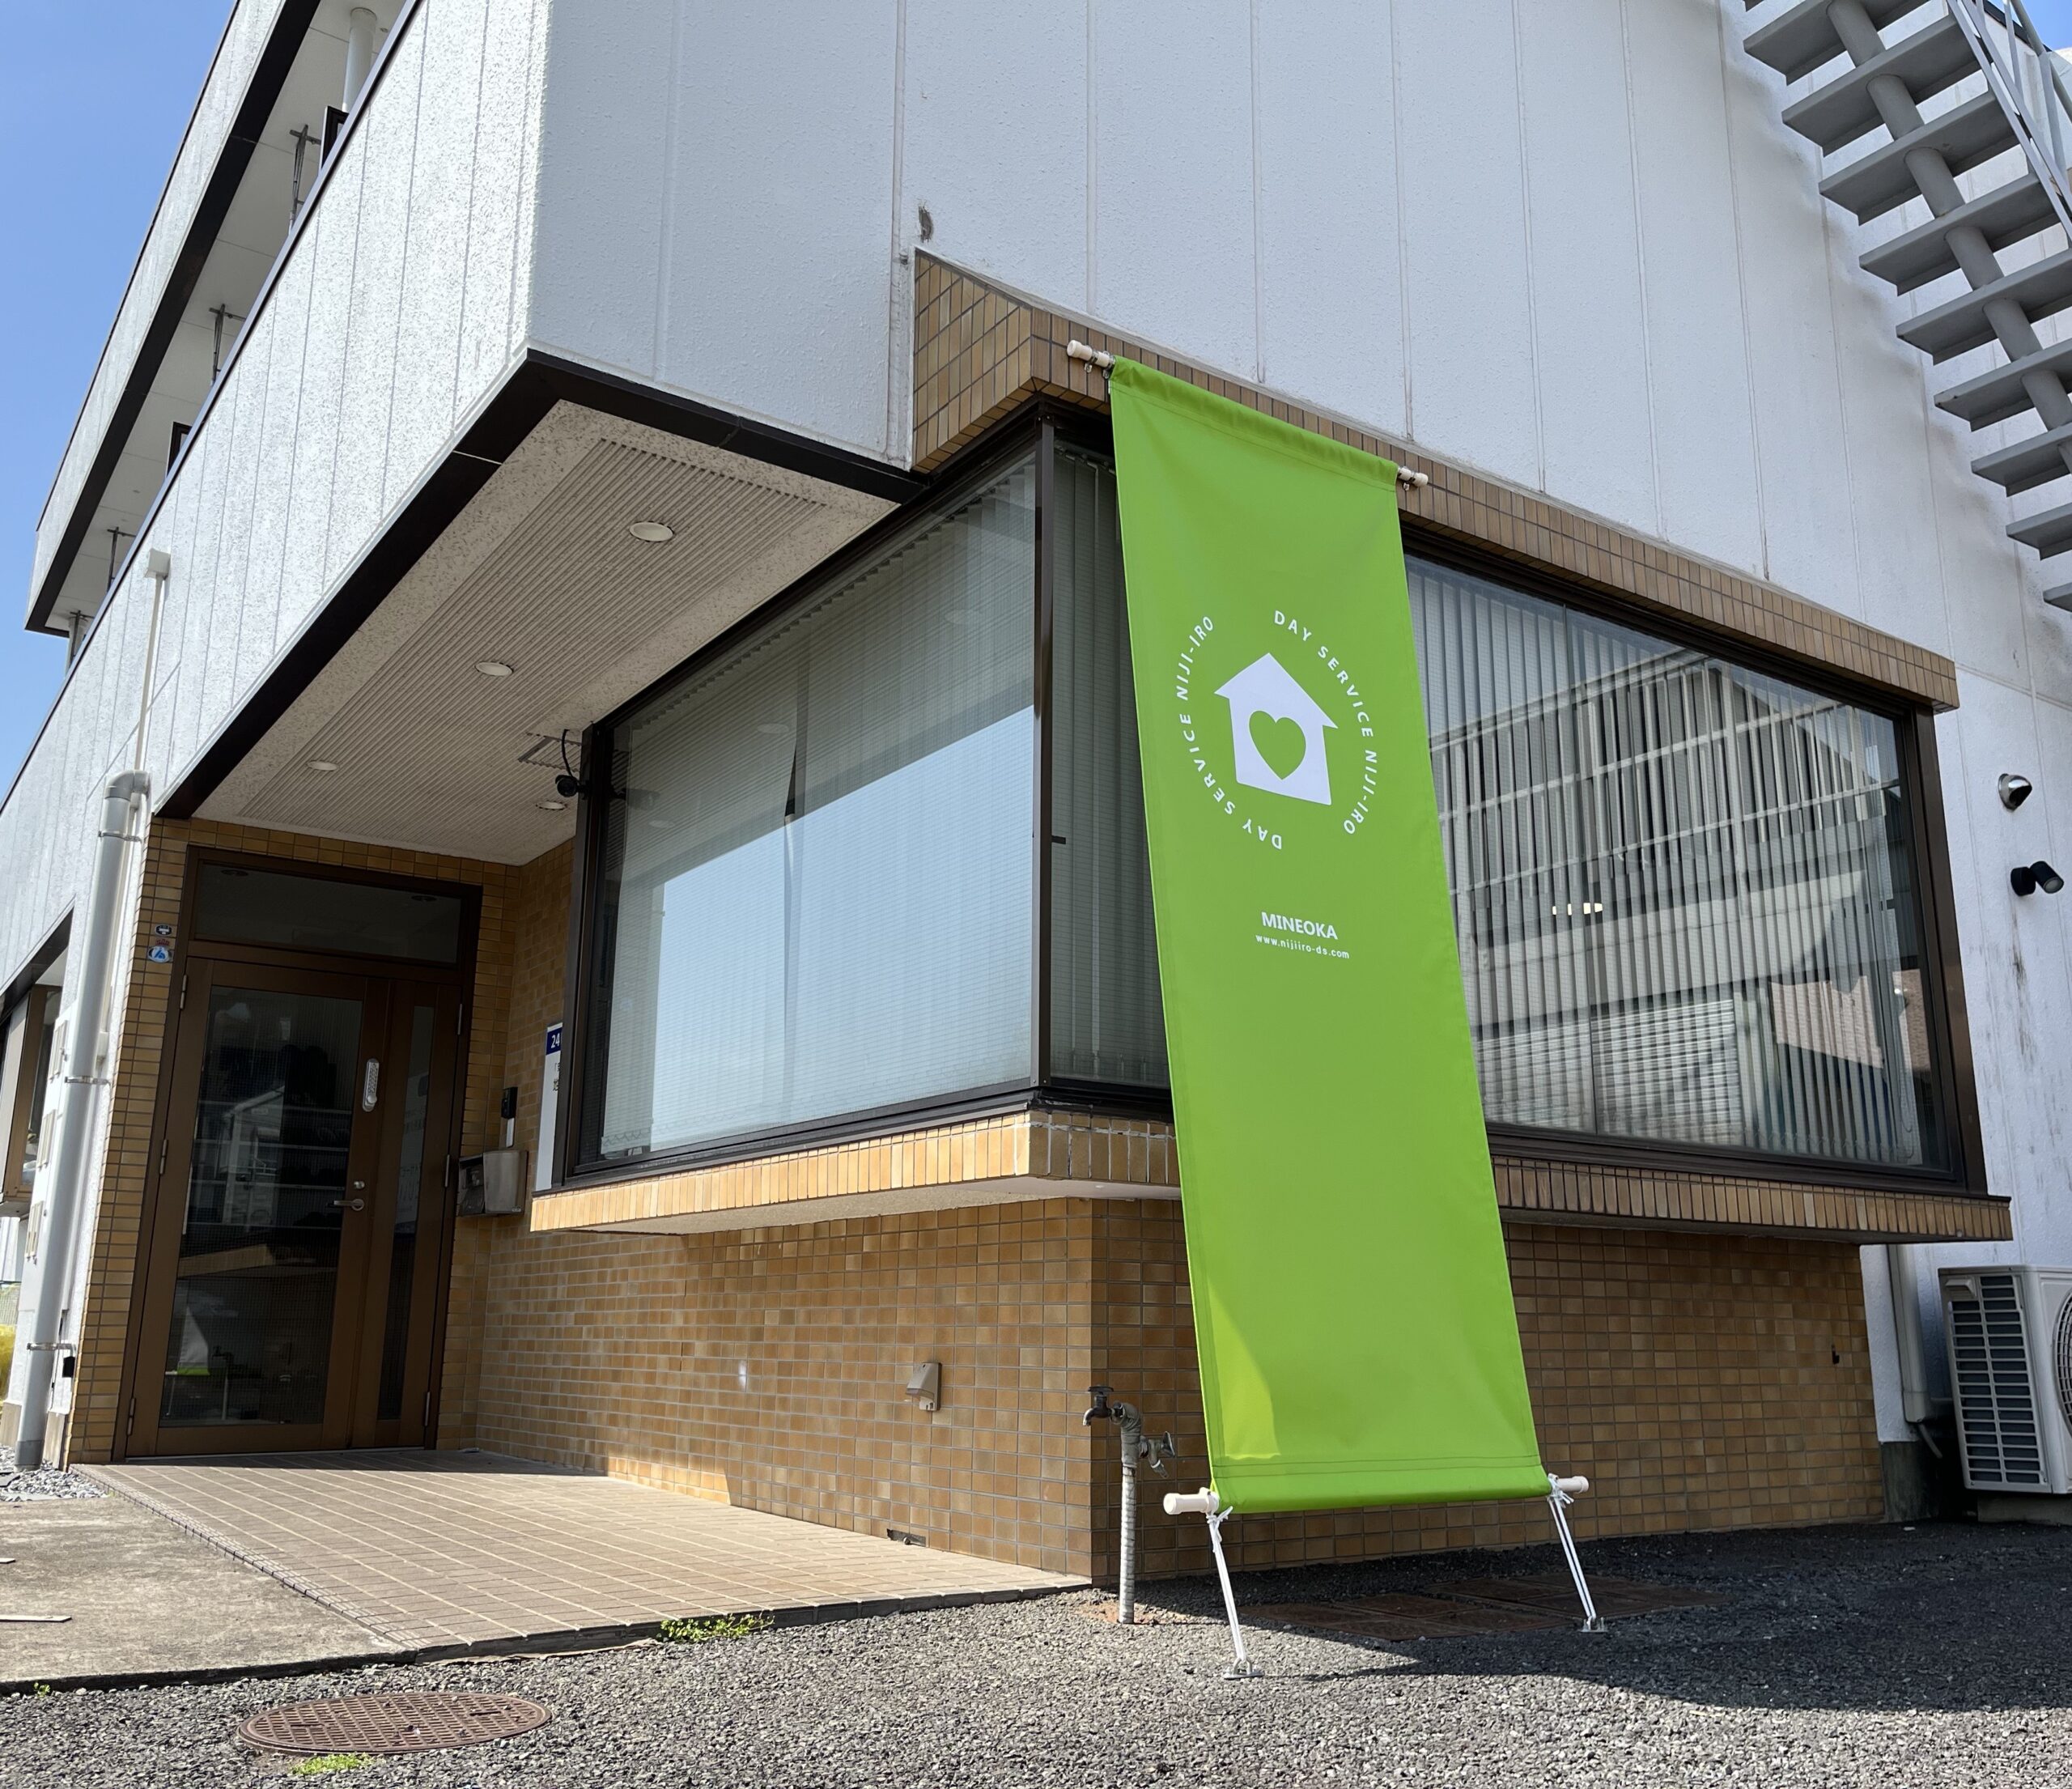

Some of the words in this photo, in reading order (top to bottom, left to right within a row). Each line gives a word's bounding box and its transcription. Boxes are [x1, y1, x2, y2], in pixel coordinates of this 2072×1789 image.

[1275, 610, 1311, 641] DAY
[1176, 617, 1213, 700] NIJI-IRO
[1318, 646, 1374, 737] SERVICE
[1179, 714, 1235, 814] SERVICE
[1344, 750, 1378, 834] NIJI-IRO
[1242, 818, 1282, 849] DAY
[1255, 934, 1350, 959] www.nijiiro-ds.com
[1261, 911, 1338, 940] MINEOKA
